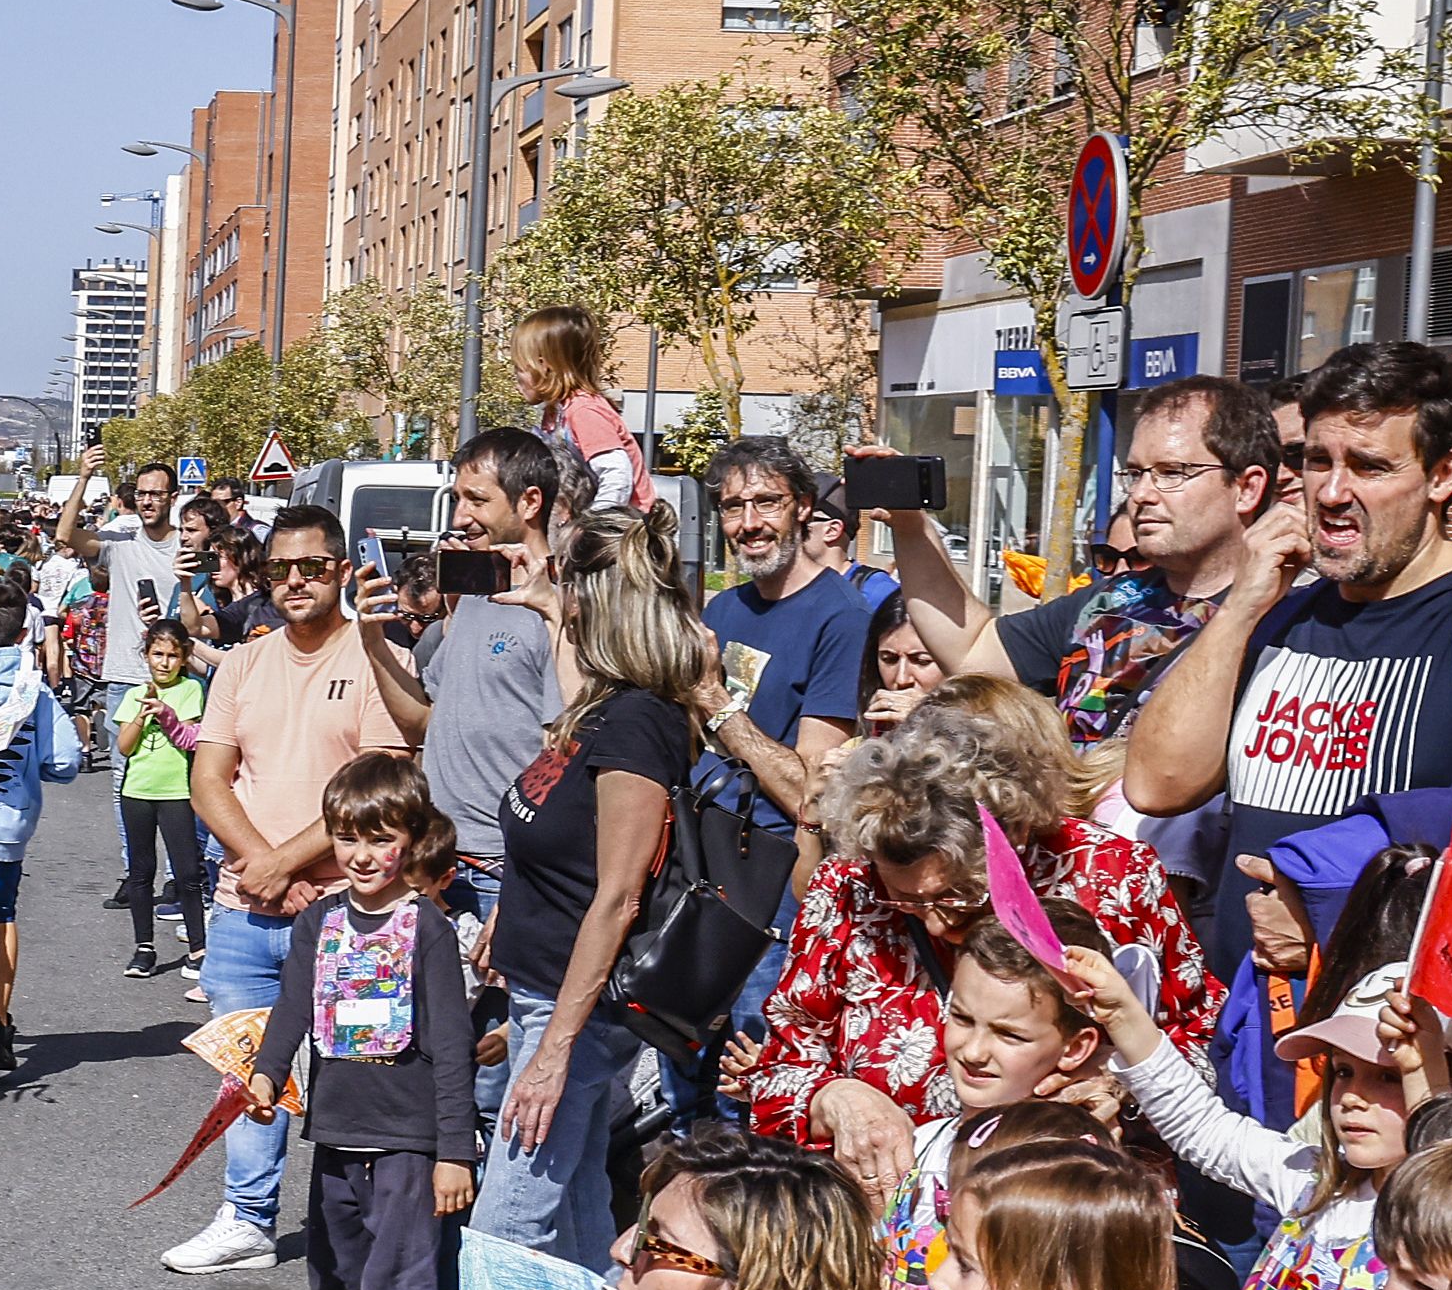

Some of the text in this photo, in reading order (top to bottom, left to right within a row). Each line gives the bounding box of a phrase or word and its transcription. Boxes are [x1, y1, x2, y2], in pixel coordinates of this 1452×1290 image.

[998, 367, 1037, 379] BBVA
[1144, 346, 1177, 378] BBVA
[1243, 725, 1370, 771] JONES
